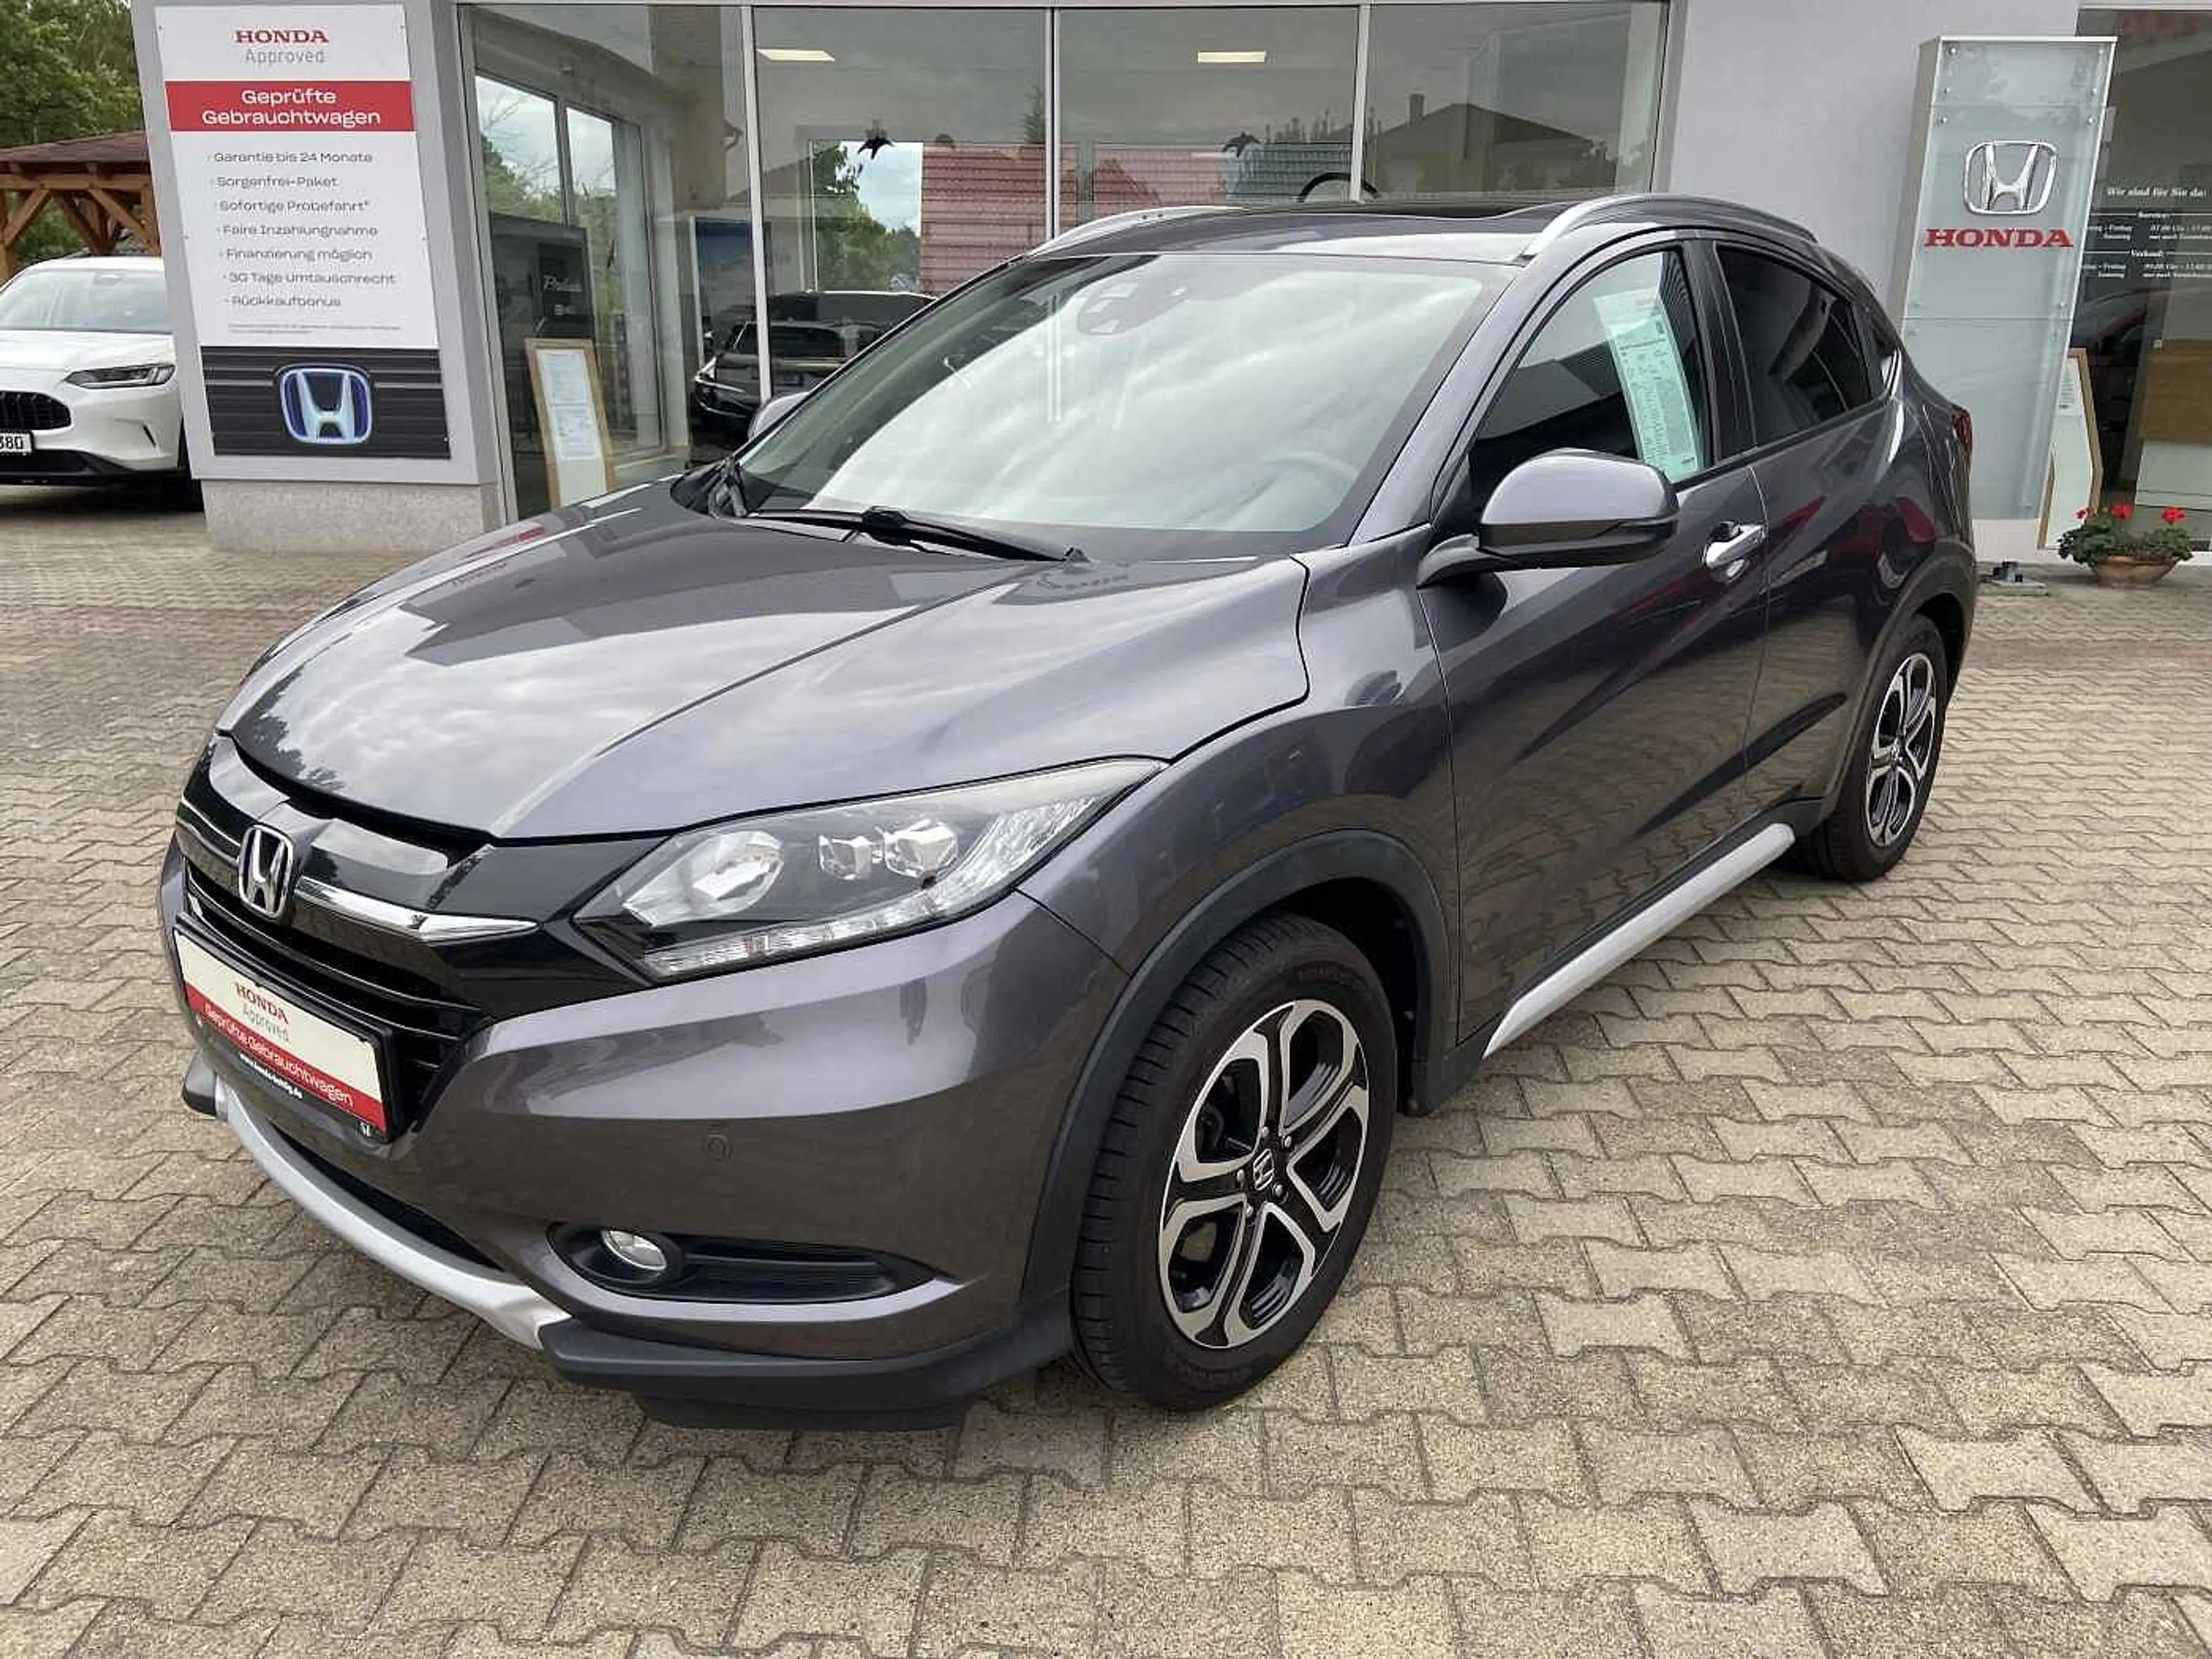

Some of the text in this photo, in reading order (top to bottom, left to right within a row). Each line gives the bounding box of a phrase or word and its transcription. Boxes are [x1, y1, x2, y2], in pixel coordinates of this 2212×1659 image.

[234, 30, 329, 43] HONDA
[245, 49, 325, 63] Approved
[241, 88, 336, 105] Geprüfte
[202, 110, 380, 128] Gebrauchtwagen
[214, 153, 373, 162] Garantie bis 24 Monate
[217, 177, 338, 189] Sorgenfrei-Paket
[220, 200, 285, 213] Sofortige
[223, 225, 377, 237] Faire Inzahlungnahme
[1924, 229, 2074, 248] HONDA
[226, 248, 373, 262] Finanzierung möglich
[250, 272, 283, 285] Tage
[235, 982, 289, 1024] HONDA
[248, 1036, 354, 1108] Gebrauchtwagen
